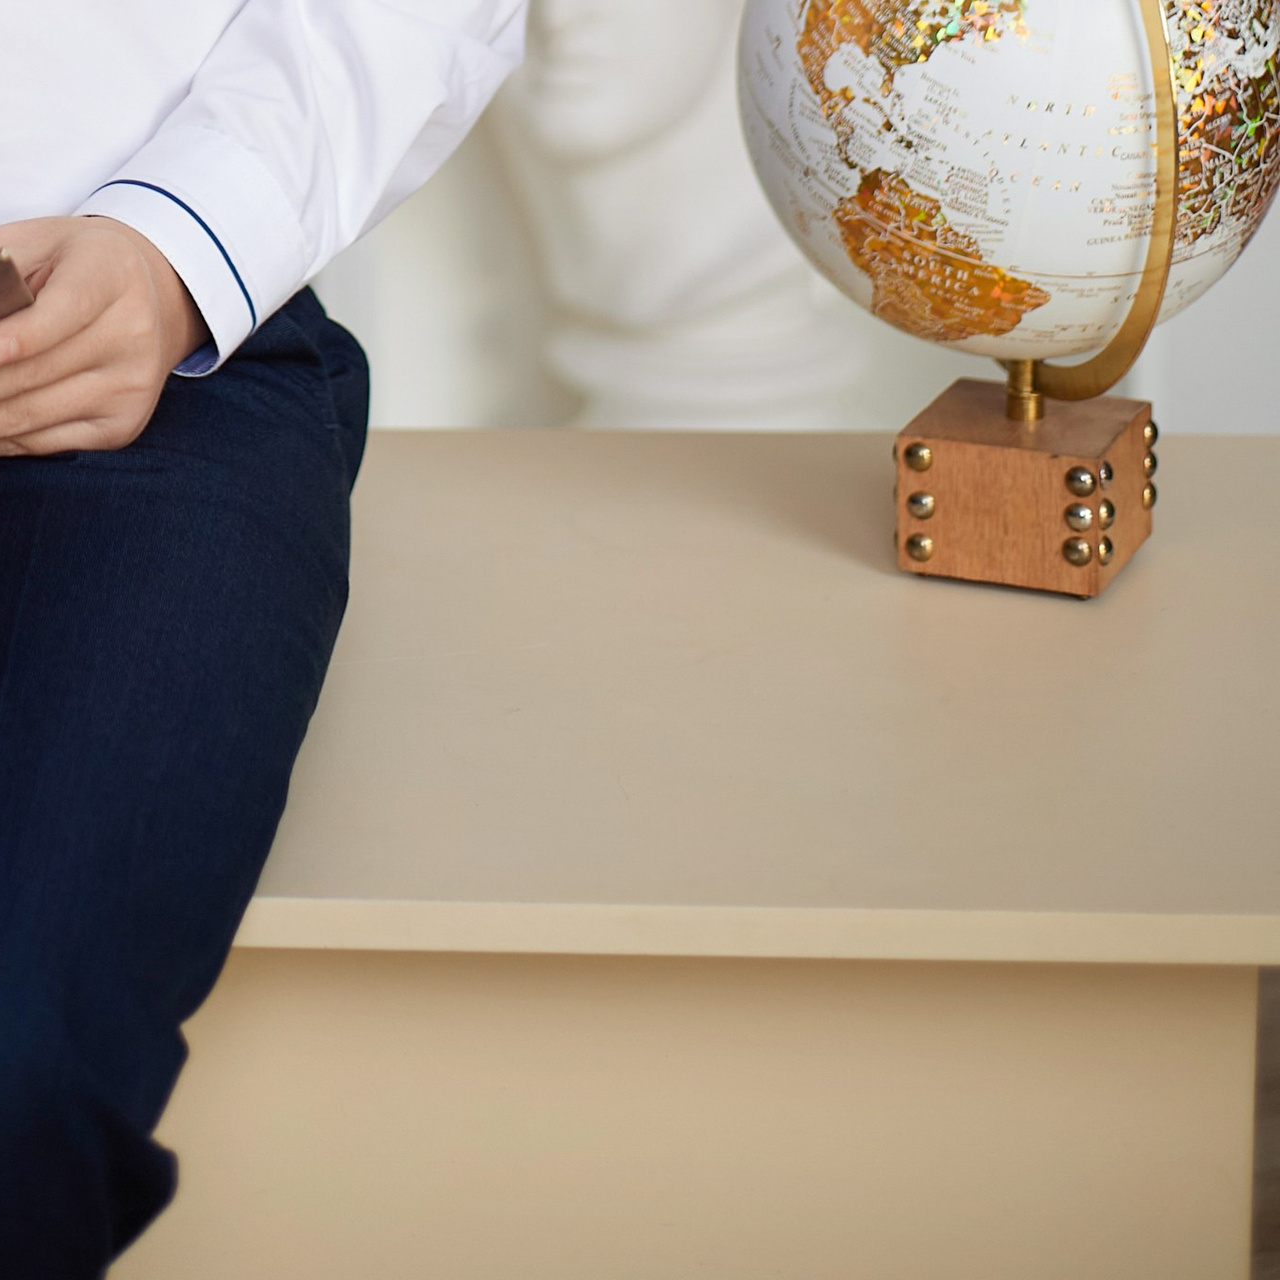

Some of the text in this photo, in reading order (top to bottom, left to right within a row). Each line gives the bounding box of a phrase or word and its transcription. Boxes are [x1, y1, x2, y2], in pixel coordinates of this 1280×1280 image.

[1007, 94, 1097, 117] NORTH
[979, 126, 1121, 158] ATLANTIC
[988, 167, 1083, 192] OCEAN
[887, 258, 981, 297] AMERICA
[902, 250, 969, 281] SOUTH
